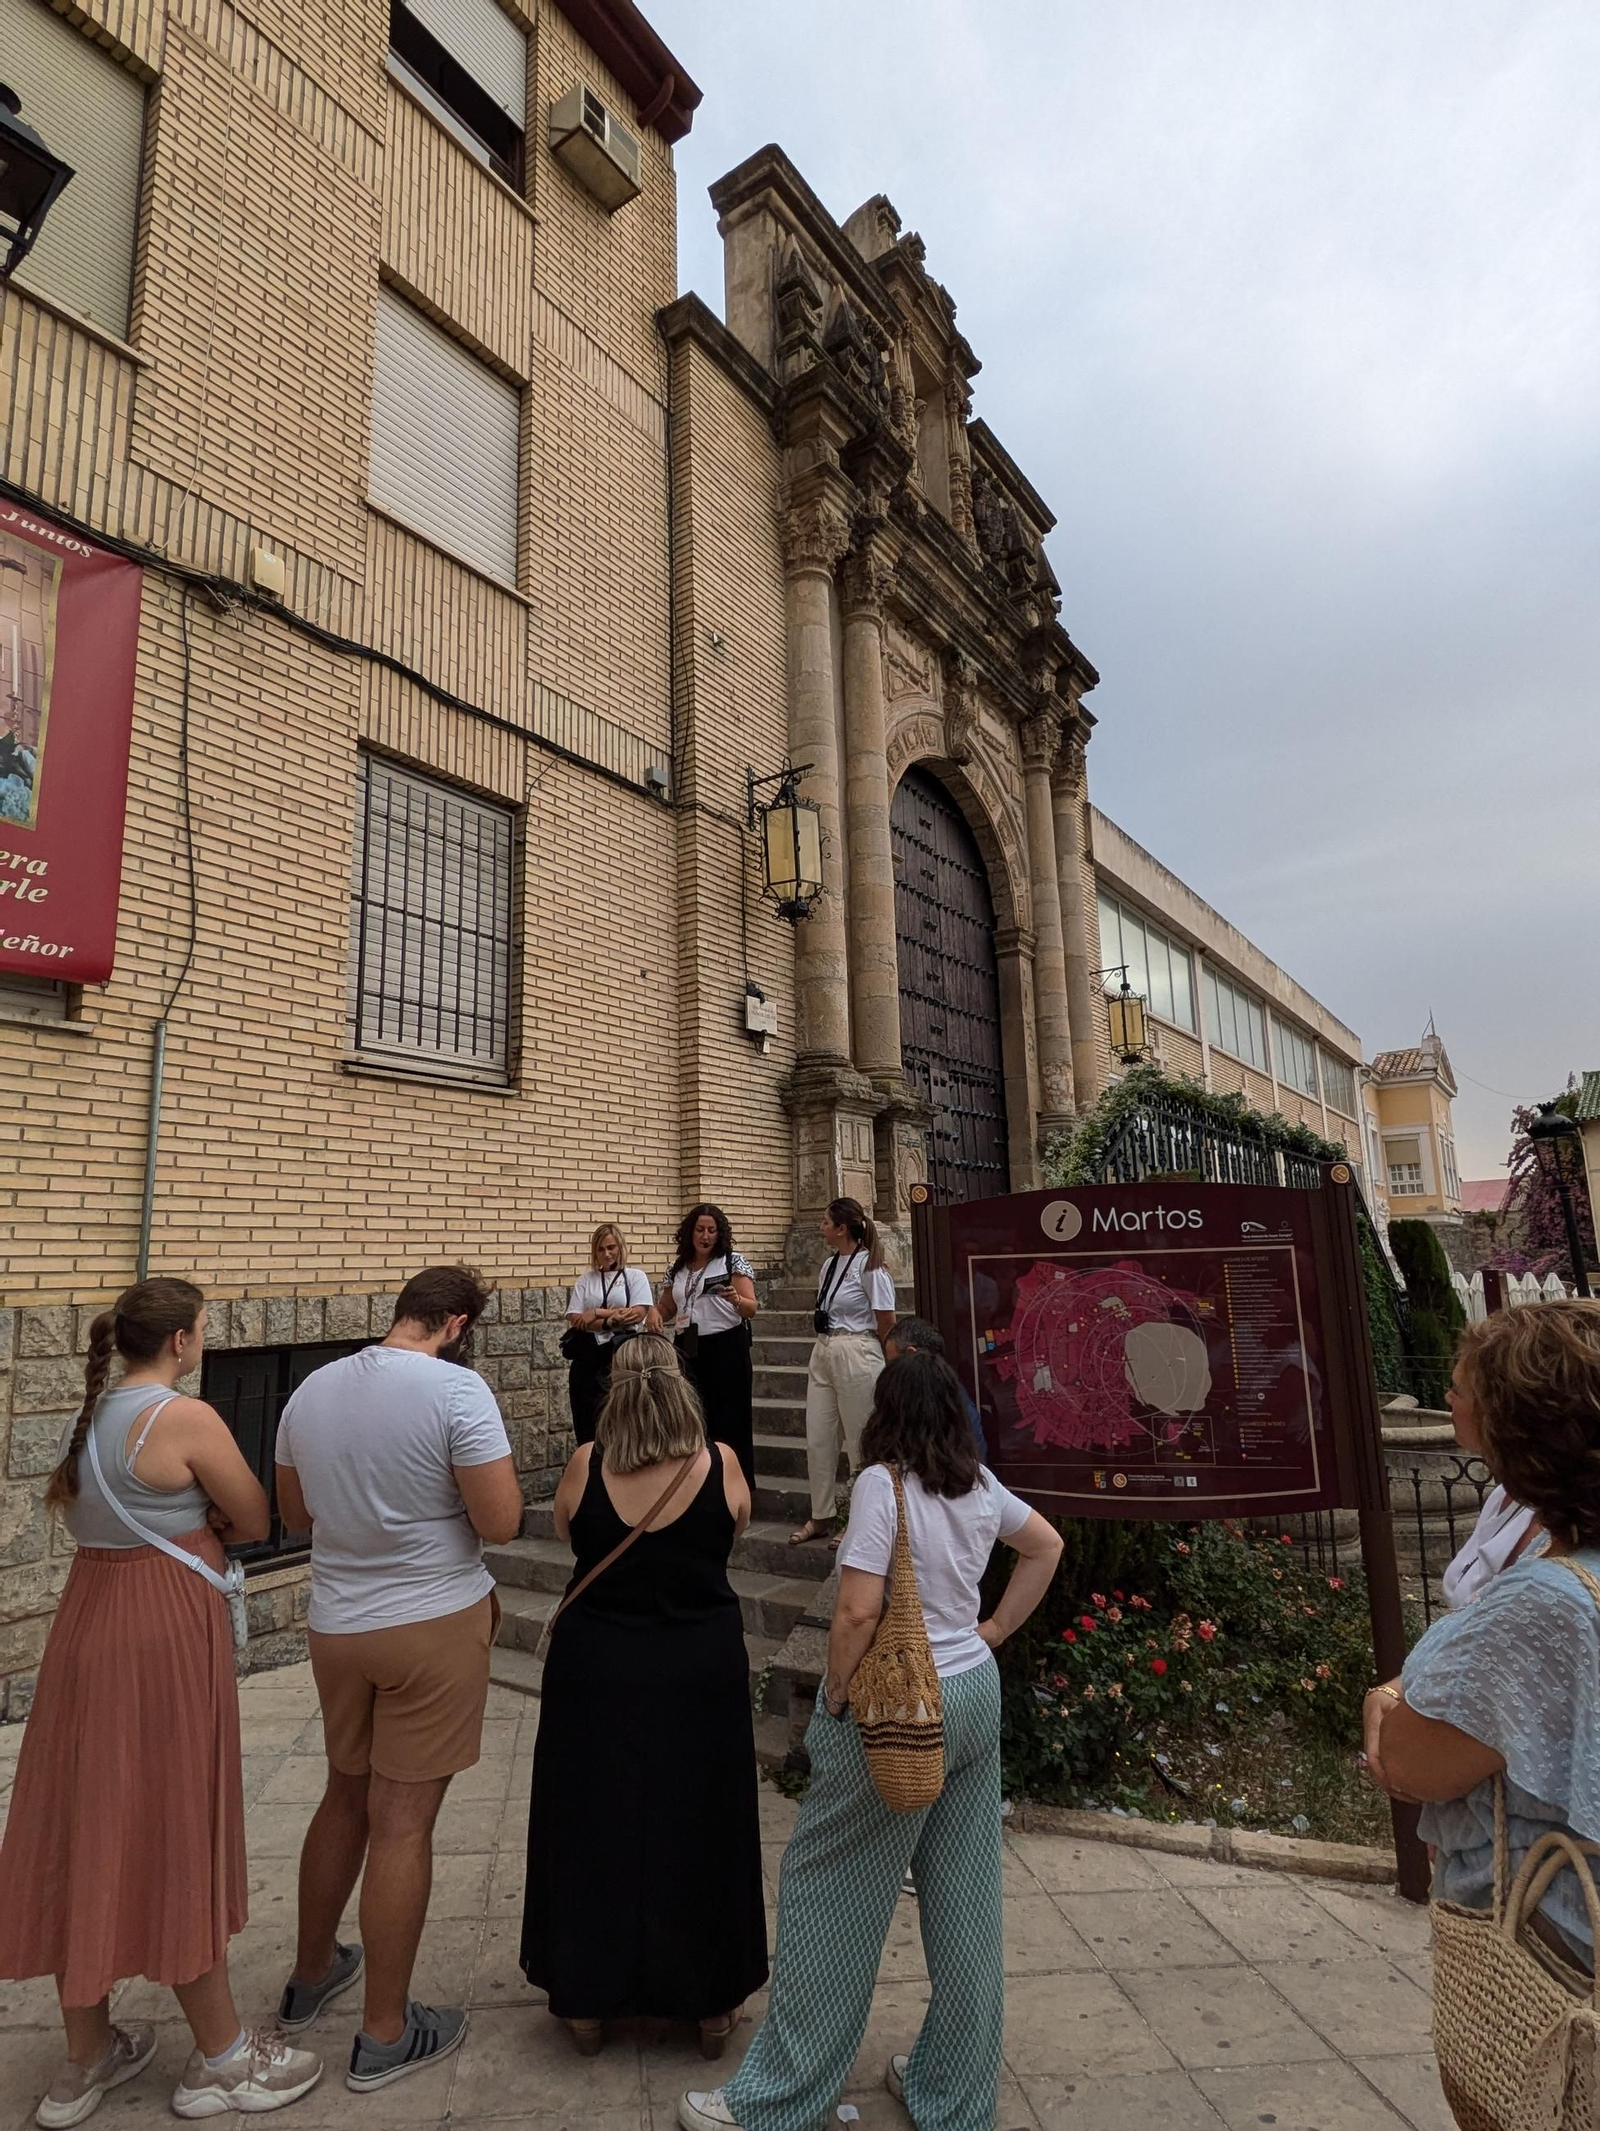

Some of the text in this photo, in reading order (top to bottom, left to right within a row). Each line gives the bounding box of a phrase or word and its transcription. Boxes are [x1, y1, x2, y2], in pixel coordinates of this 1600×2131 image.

[1, 510, 93, 558] Juntos
[0, 929, 74, 958] eñor
[1092, 1205, 1203, 1232] Martos
